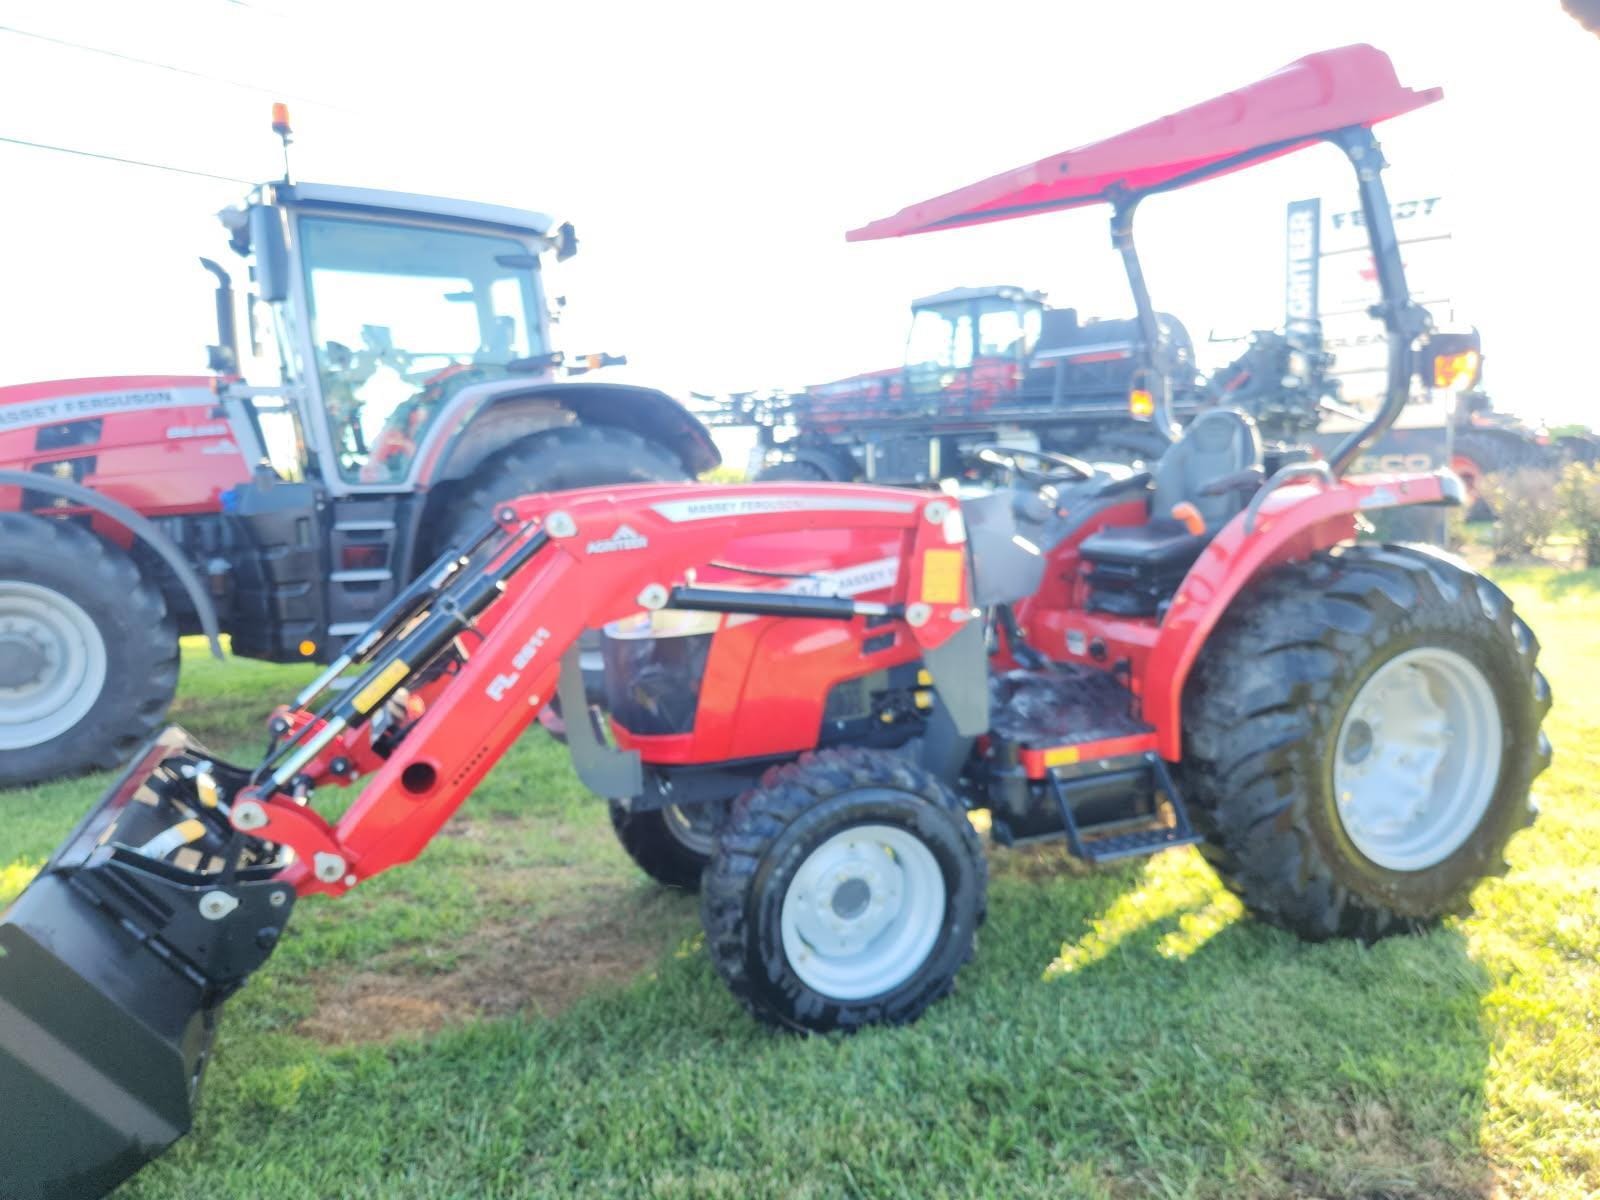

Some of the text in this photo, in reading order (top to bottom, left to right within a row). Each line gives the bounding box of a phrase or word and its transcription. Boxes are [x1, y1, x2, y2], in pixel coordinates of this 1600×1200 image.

[1332, 197, 1441, 229] FEDT
[64, 391, 172, 412] FERGUSON
[688, 502, 736, 514] MASSEY
[486, 671, 520, 702] FL
